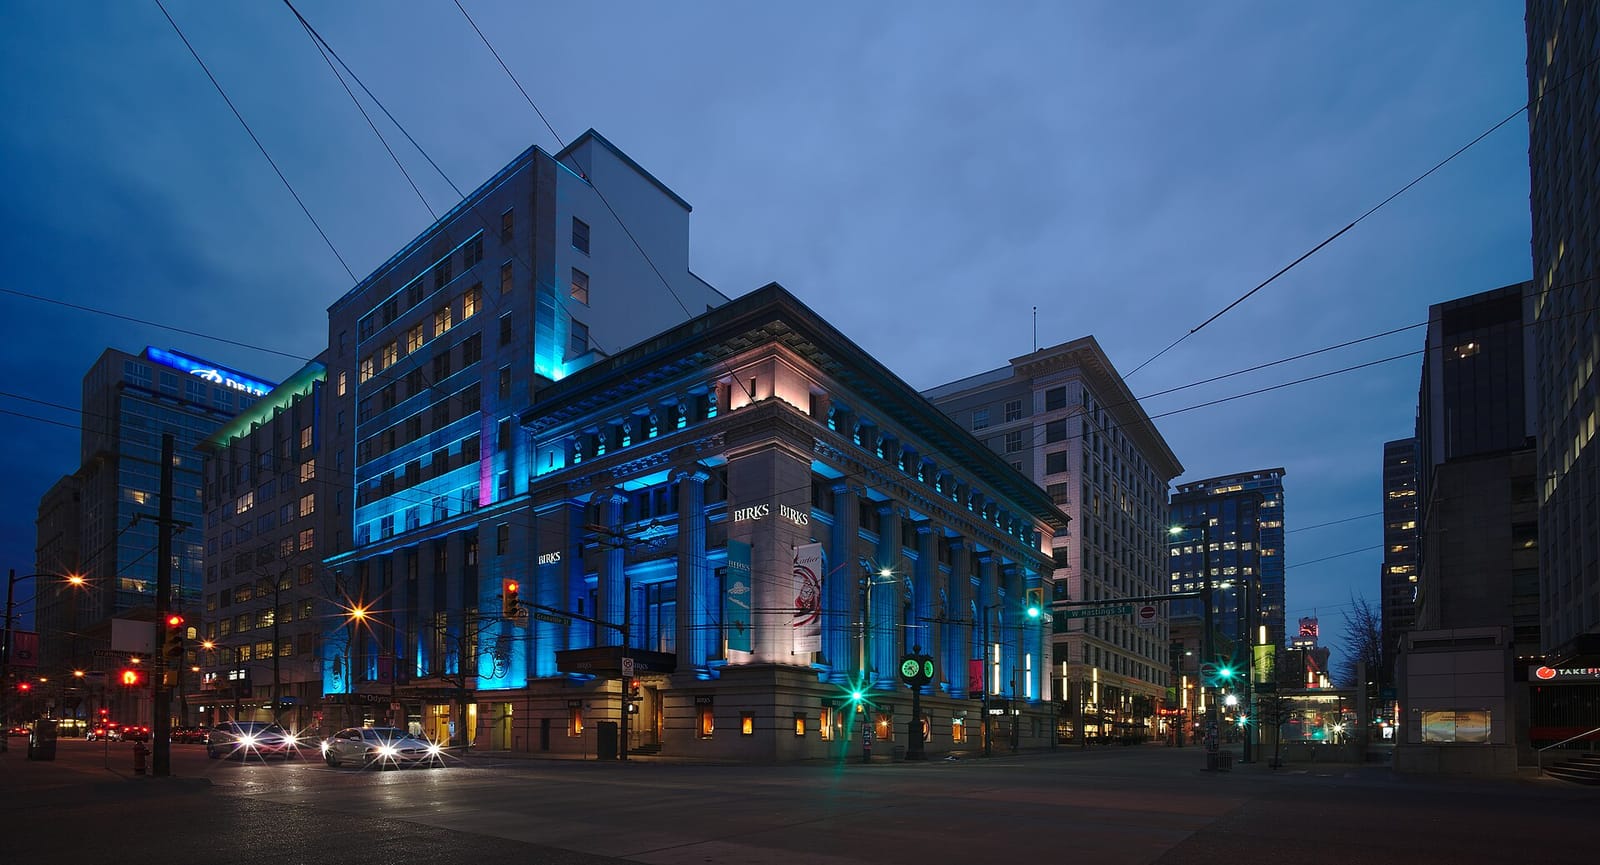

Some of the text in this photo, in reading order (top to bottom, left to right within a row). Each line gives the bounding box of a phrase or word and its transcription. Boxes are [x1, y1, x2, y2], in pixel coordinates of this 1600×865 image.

[226, 378, 271, 397] DELT
[734, 504, 769, 522] BIRKS
[780, 504, 809, 525] BIRKS
[538, 551, 561, 565] BIRKS
[1082, 607, 1116, 616] Hastings
